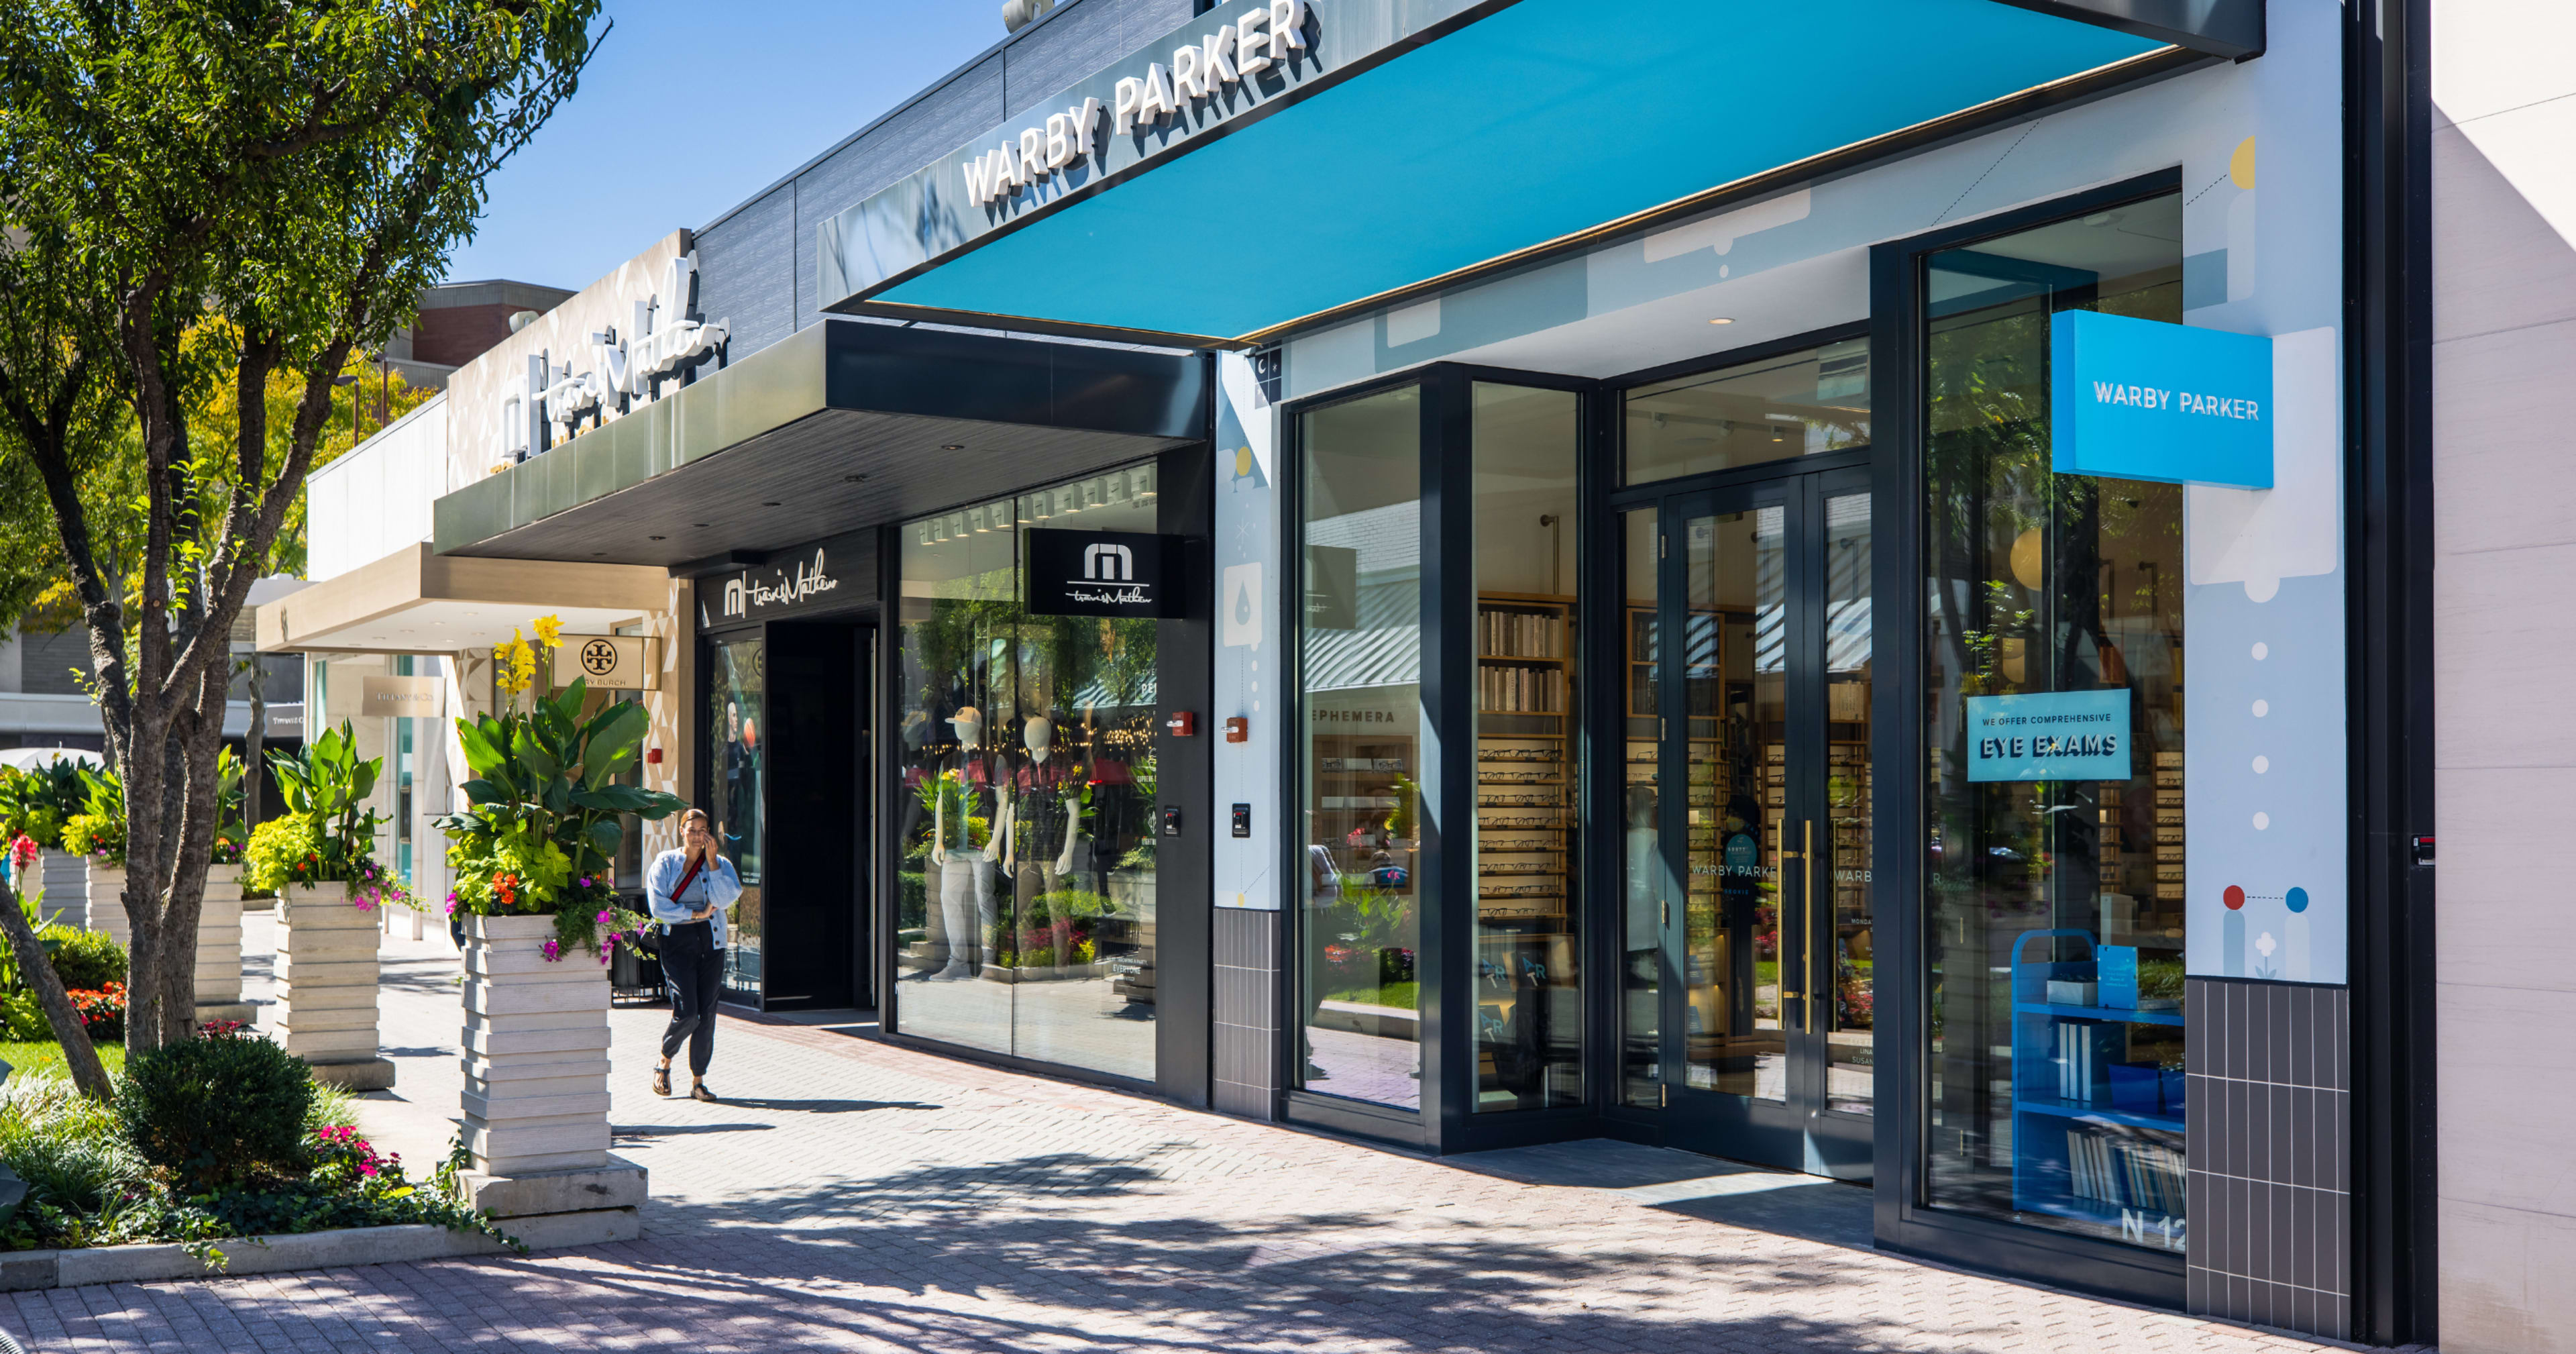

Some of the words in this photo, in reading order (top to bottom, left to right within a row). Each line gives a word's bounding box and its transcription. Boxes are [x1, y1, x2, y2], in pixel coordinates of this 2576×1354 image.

[963, 97, 1099, 207] WARBY
[1116, 0, 1305, 136] PARKER
[2093, 380, 2171, 411] WARBY
[2180, 392, 2259, 421] PARKER
[1982, 718, 1995, 726] WE
[1998, 717, 2027, 725] OFFER
[2031, 713, 2111, 724] COMPREHENSIVE
[1980, 737, 2024, 759] EYE
[2033, 732, 2118, 758] EXAMS
[1692, 864, 1733, 877] WARBY
[1738, 866, 1777, 878] PARKE
[1835, 870, 1872, 882] WARB
[1113, 964, 1140, 974] EVERYONE
[2122, 1208, 2143, 1243] N
